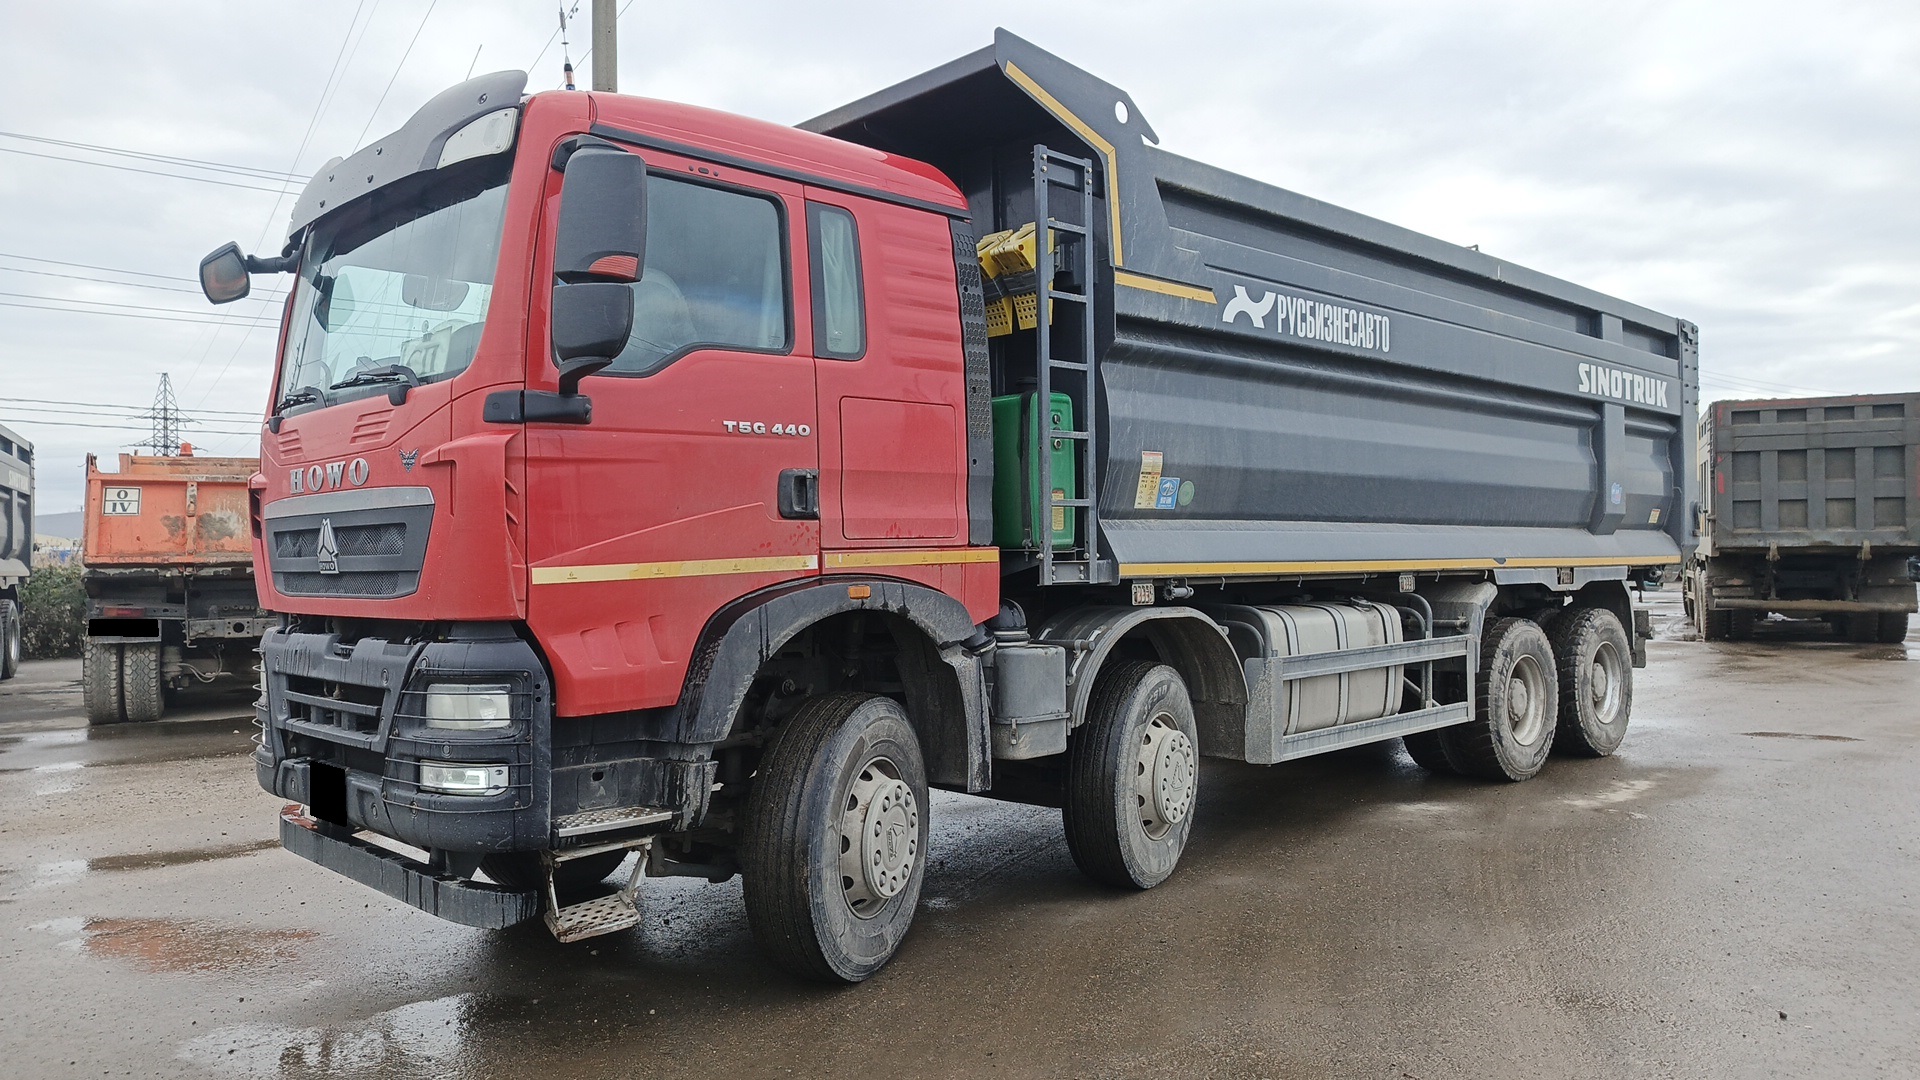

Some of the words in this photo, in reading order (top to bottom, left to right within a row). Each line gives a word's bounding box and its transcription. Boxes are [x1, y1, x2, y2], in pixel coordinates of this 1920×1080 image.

[1277, 294, 1390, 353] РУСБИЗНЕСАВТО
[1578, 362, 1668, 409] SINOTRUK
[723, 420, 766, 434] T5G
[771, 423, 811, 436] 440
[289, 457, 370, 494] HOWO
[111, 502, 132, 513] IV
